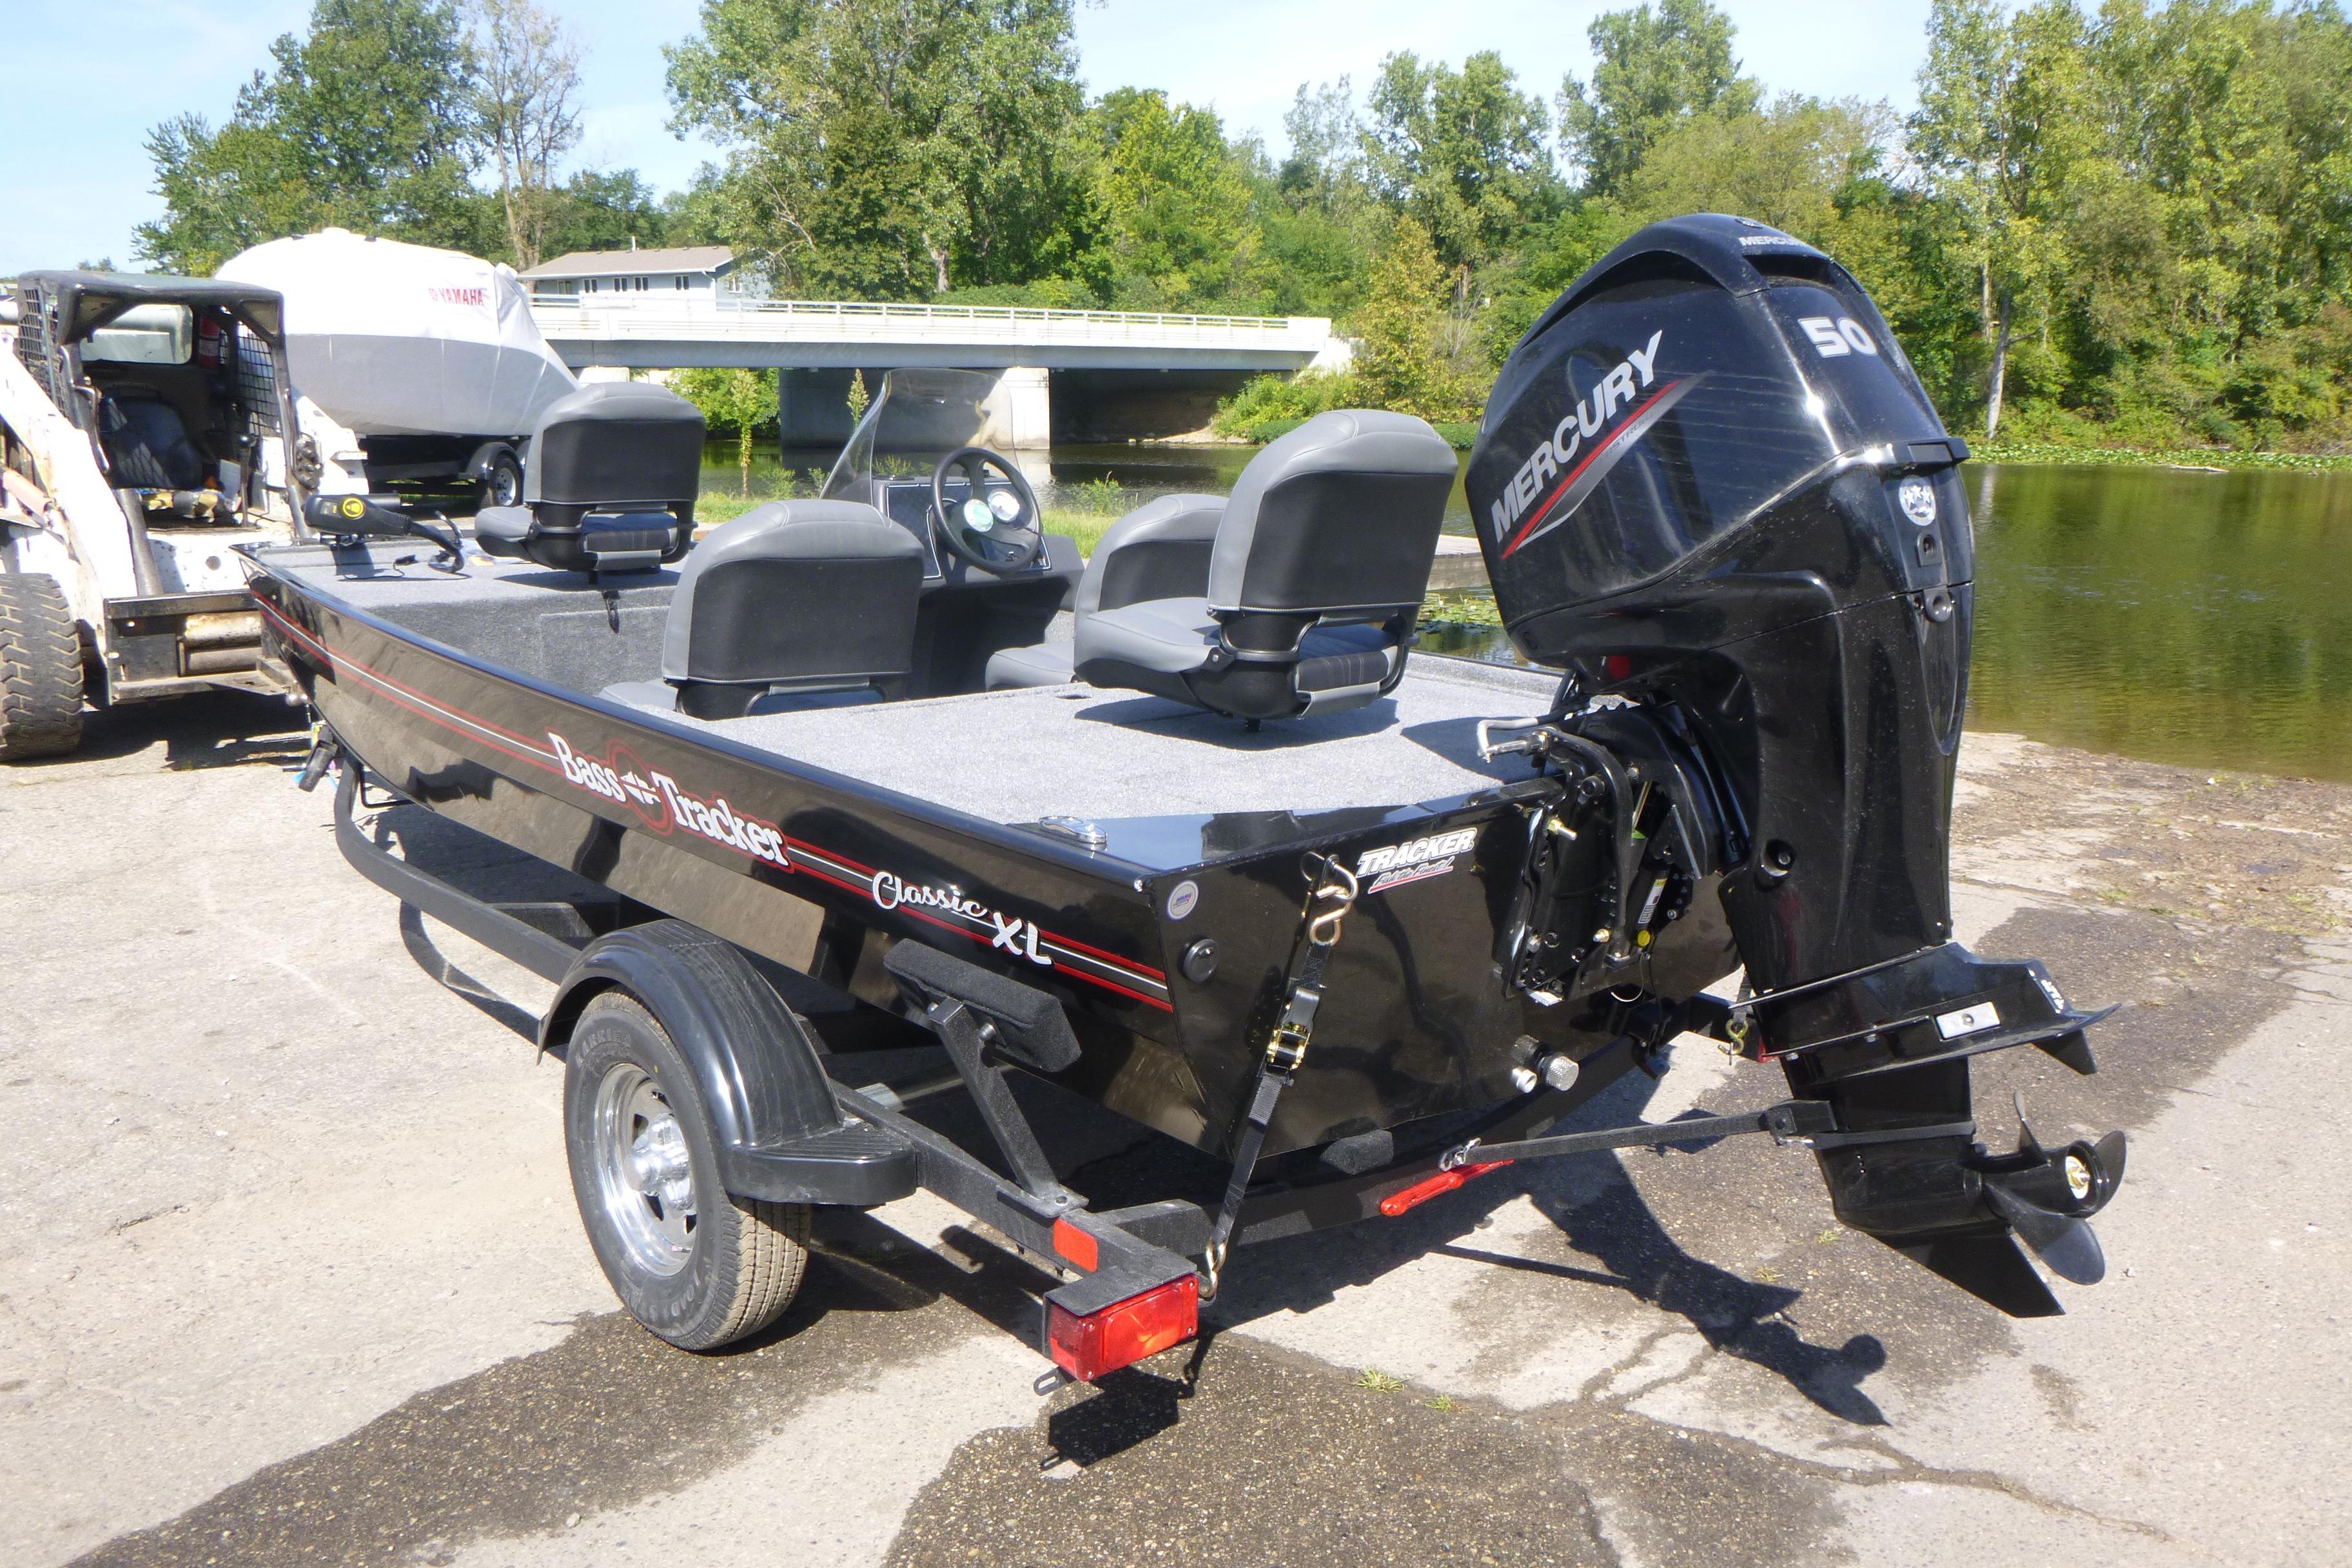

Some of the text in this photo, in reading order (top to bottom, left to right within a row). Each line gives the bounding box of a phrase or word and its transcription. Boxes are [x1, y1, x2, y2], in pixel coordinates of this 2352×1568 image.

[438, 288, 484, 306] YAMAHA
[1798, 316, 1879, 358] 50
[1491, 329, 1663, 544] MERCURY
[548, 731, 788, 868] Bass Tracker
[1357, 828, 1476, 877] TRACKER
[872, 870, 986, 917] Classic
[991, 912, 1053, 965] XL
